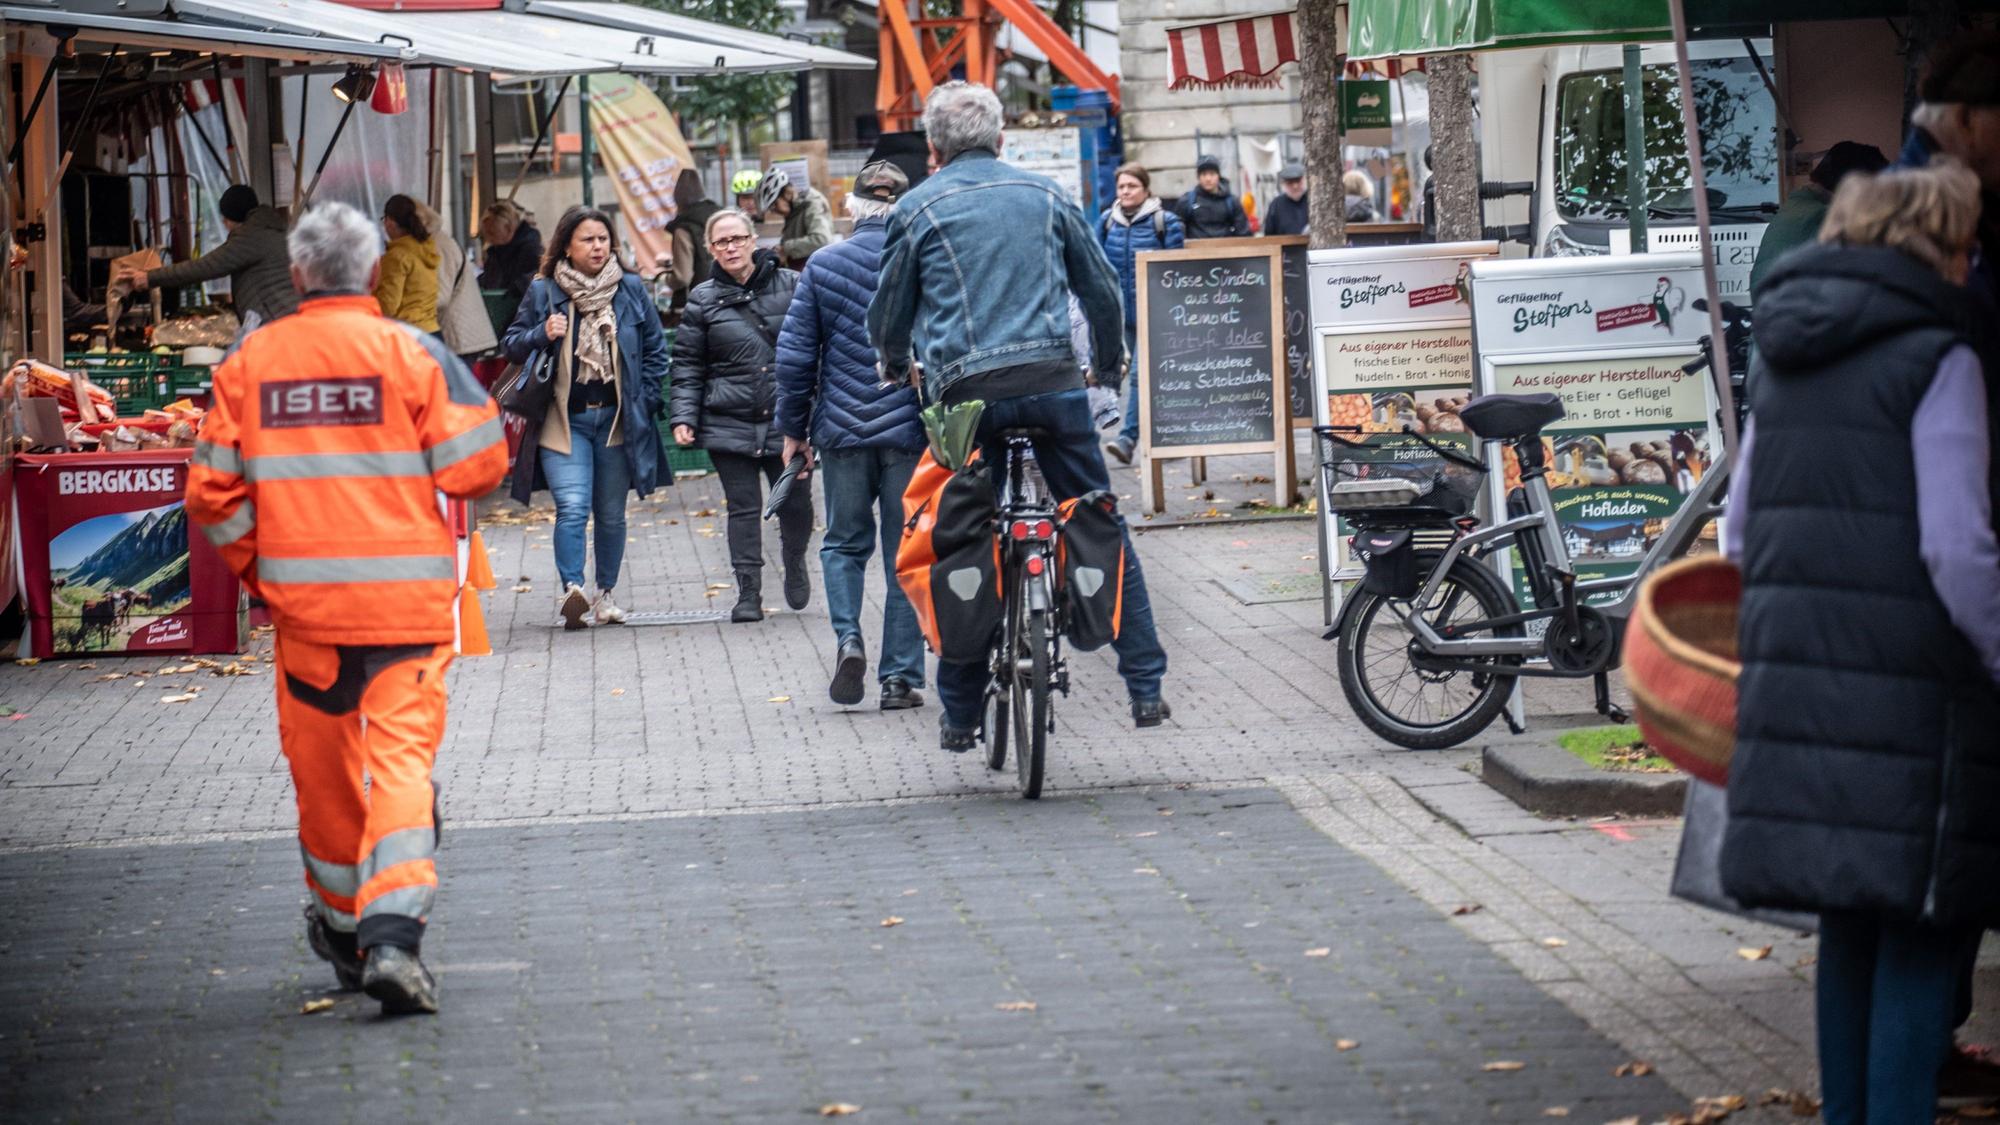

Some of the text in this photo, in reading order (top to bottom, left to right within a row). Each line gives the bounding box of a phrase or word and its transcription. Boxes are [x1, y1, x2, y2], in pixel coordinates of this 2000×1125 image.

[1205, 267, 1266, 287] Sünden
[1327, 275, 1382, 286] Geflügelhof
[1184, 288, 1244, 304] aus dem
[1340, 282, 1406, 309] Steffens
[1497, 292, 1564, 304] Geflügelhof
[1168, 304, 1241, 326] Piemont
[1513, 300, 1592, 333] Steffens
[1339, 336, 1472, 356] Aus eigener Herstellun
[1354, 352, 1469, 368] frische Eier Geflügel
[1355, 367, 1471, 383] Nudeln Brot Honig
[1512, 374, 1540, 387] Aus
[1543, 371, 1596, 389] eigener
[271, 384, 374, 415] ISER
[1577, 390, 1601, 402] Eier
[1617, 386, 1671, 400] Geflügel
[1593, 408, 1621, 420] Brot
[1635, 404, 1673, 418] Honig
[59, 467, 175, 495] BERGKÄSE
[1594, 490, 1608, 500] Sie
[1611, 490, 1632, 499] auch
[1635, 492, 1669, 506] unseren
[1581, 500, 1648, 518] Hofladen
